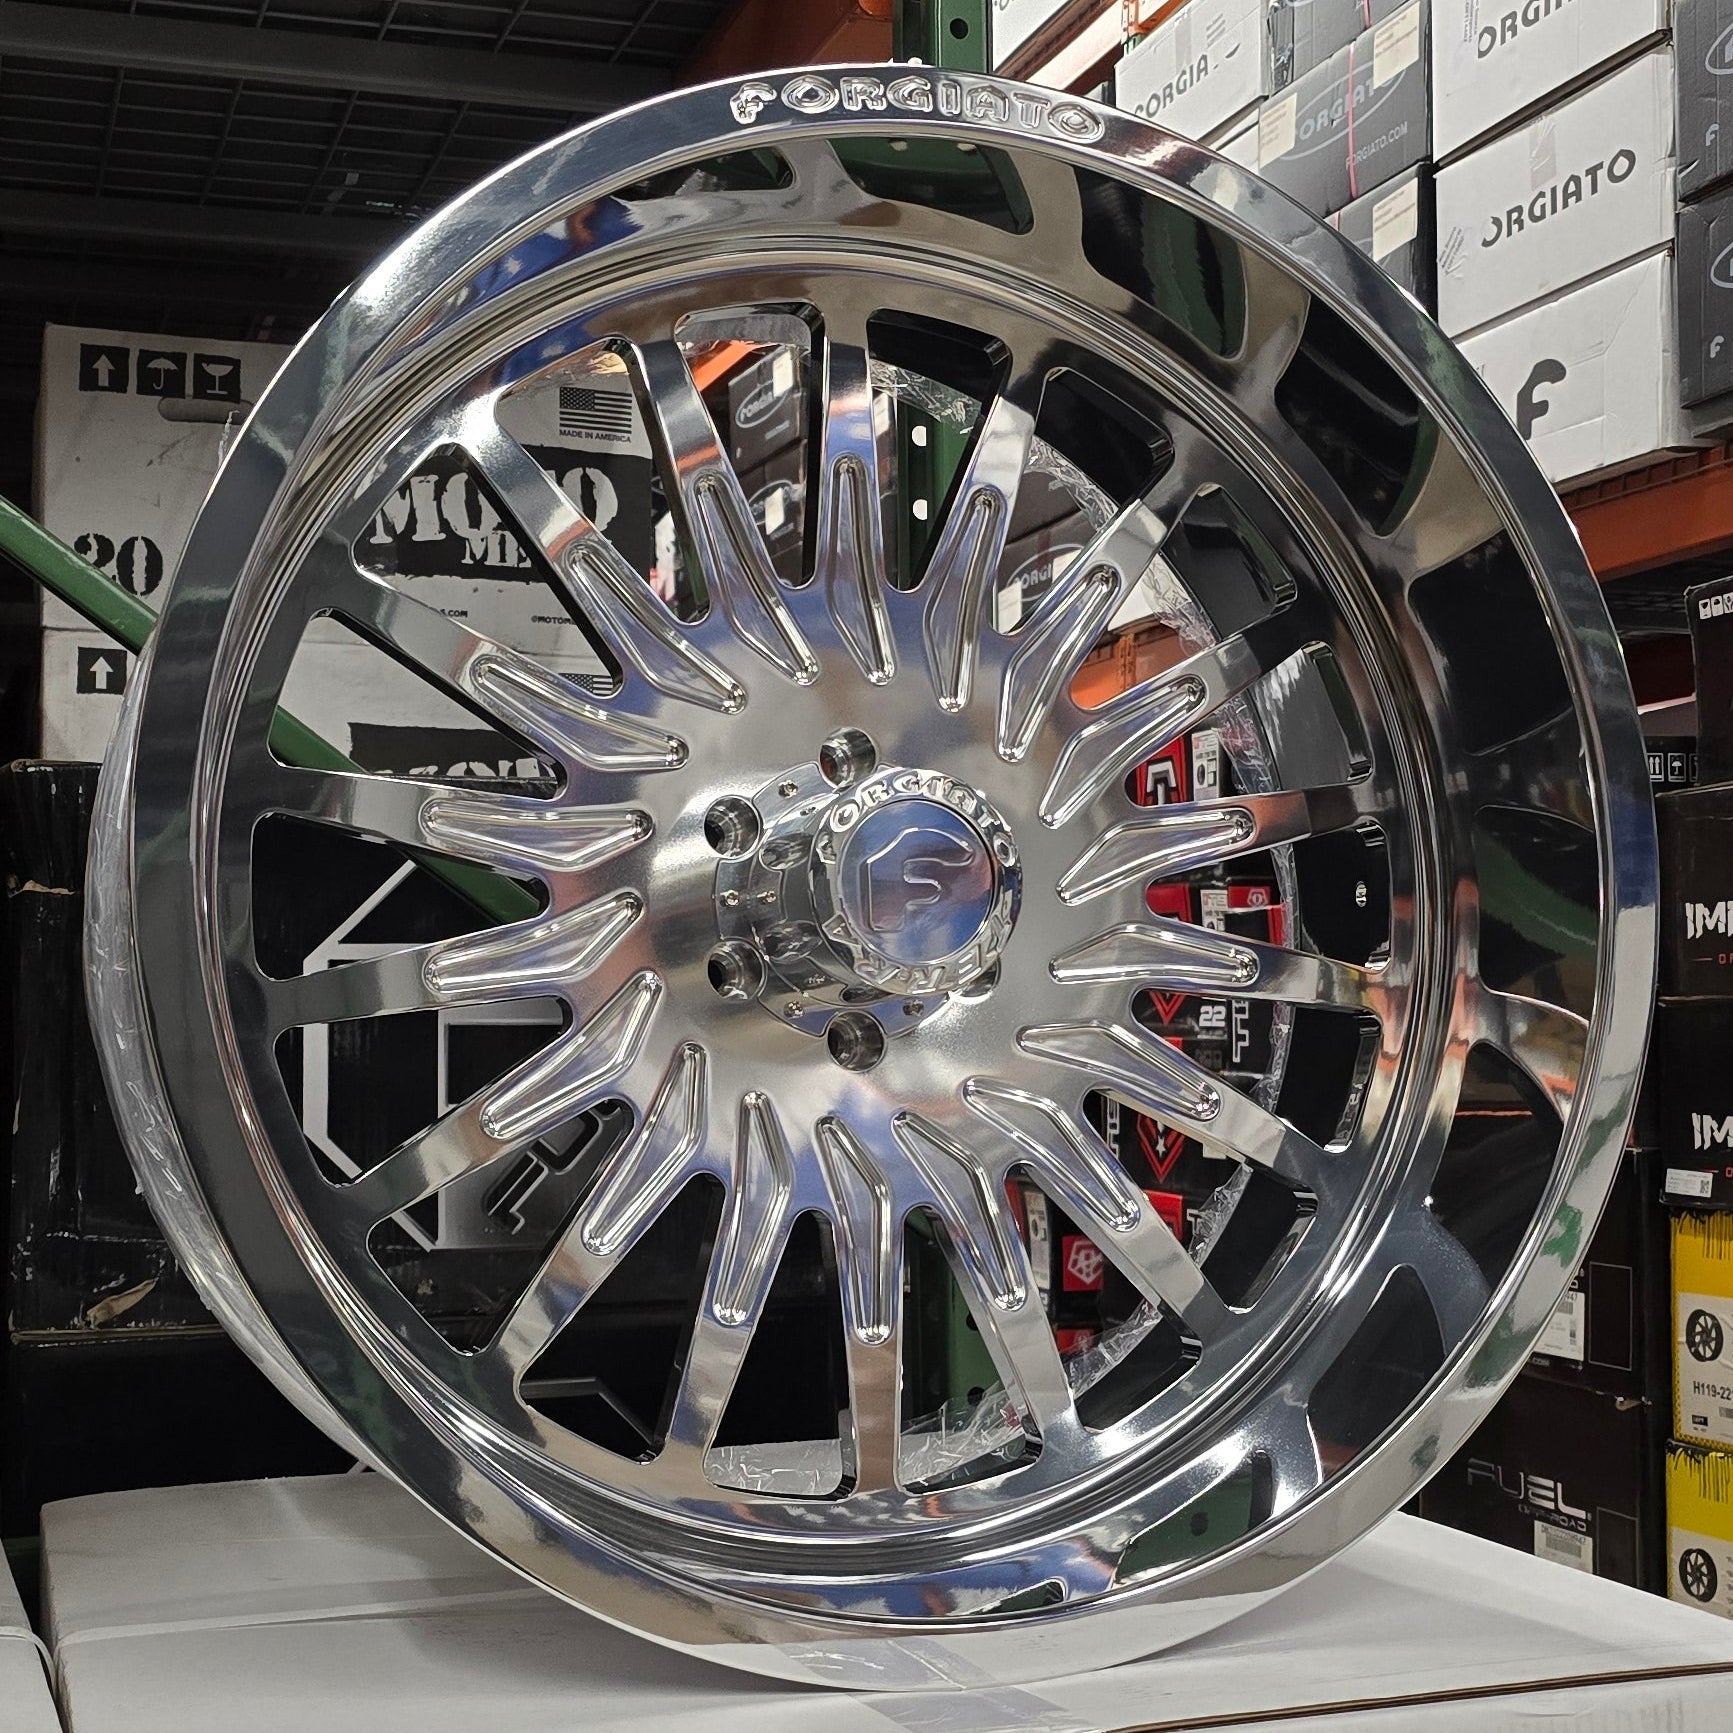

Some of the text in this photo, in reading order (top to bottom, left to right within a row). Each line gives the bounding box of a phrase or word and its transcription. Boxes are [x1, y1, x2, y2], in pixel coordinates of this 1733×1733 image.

[730, 74, 1105, 144] FORGIATO
[1481, 149, 1636, 248] ORGIATO
[1517, 358, 1567, 441] F
[559, 428, 632, 444] MADE IN AMERICA
[73, 532, 164, 597] 20
[1199, 1005, 1226, 1027] 22
[1693, 1380, 1733, 1401] H119-22
[1467, 1457, 1587, 1520] FUEL
